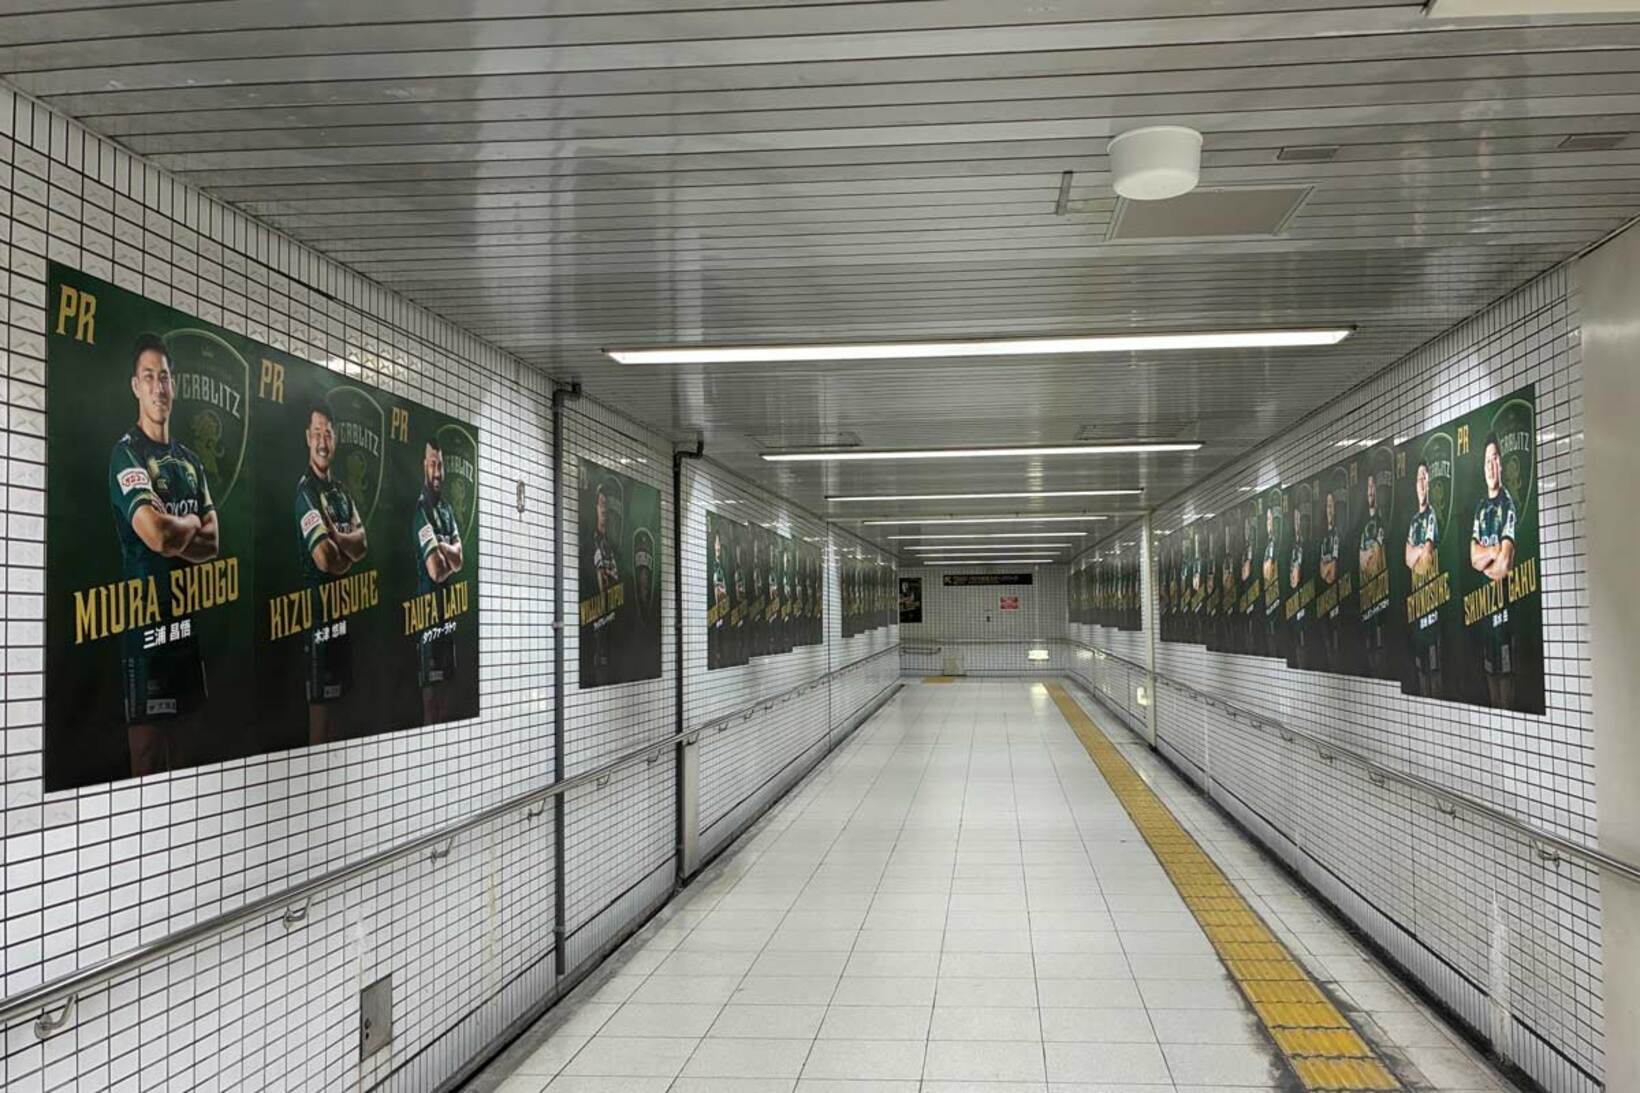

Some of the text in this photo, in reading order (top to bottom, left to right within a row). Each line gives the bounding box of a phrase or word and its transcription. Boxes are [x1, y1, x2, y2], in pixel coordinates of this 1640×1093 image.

[56, 284, 96, 345] PR
[258, 358, 285, 404] PR
[390, 407, 409, 444] PR
[1457, 424, 1469, 456] PR
[74, 557, 239, 645] MIURA SHOGO
[270, 570, 379, 641] KIZU YUSUKE
[402, 581, 469, 636] TAUFA LATU
[1463, 577, 1504, 626] SHIMIZU
[1508, 557, 1537, 603] GAKU
[143, 625, 167, 649] 三浦
